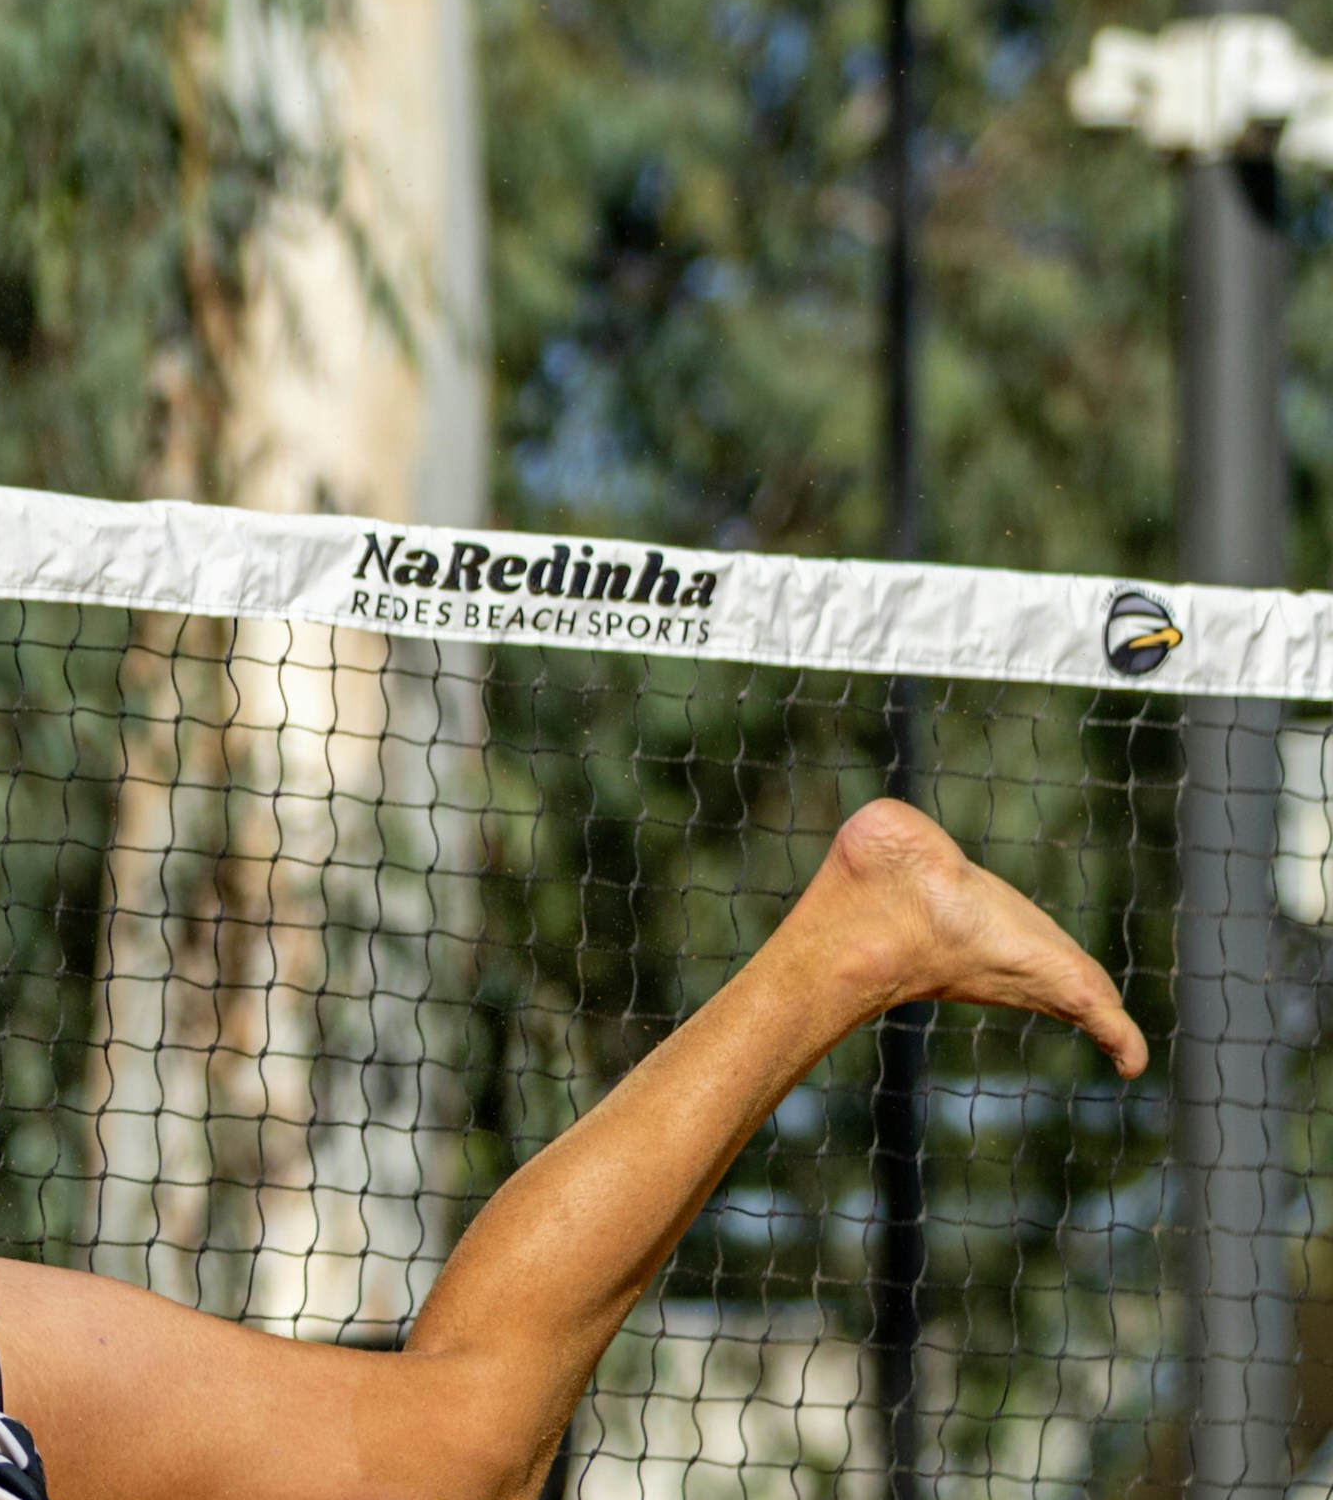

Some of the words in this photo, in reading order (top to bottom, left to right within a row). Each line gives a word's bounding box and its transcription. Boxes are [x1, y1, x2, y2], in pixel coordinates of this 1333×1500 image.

[352, 532, 717, 608] NaRedinha
[351, 590, 452, 626] REDES
[465, 604, 577, 635] BEACH
[588, 610, 710, 644] SPORTS
